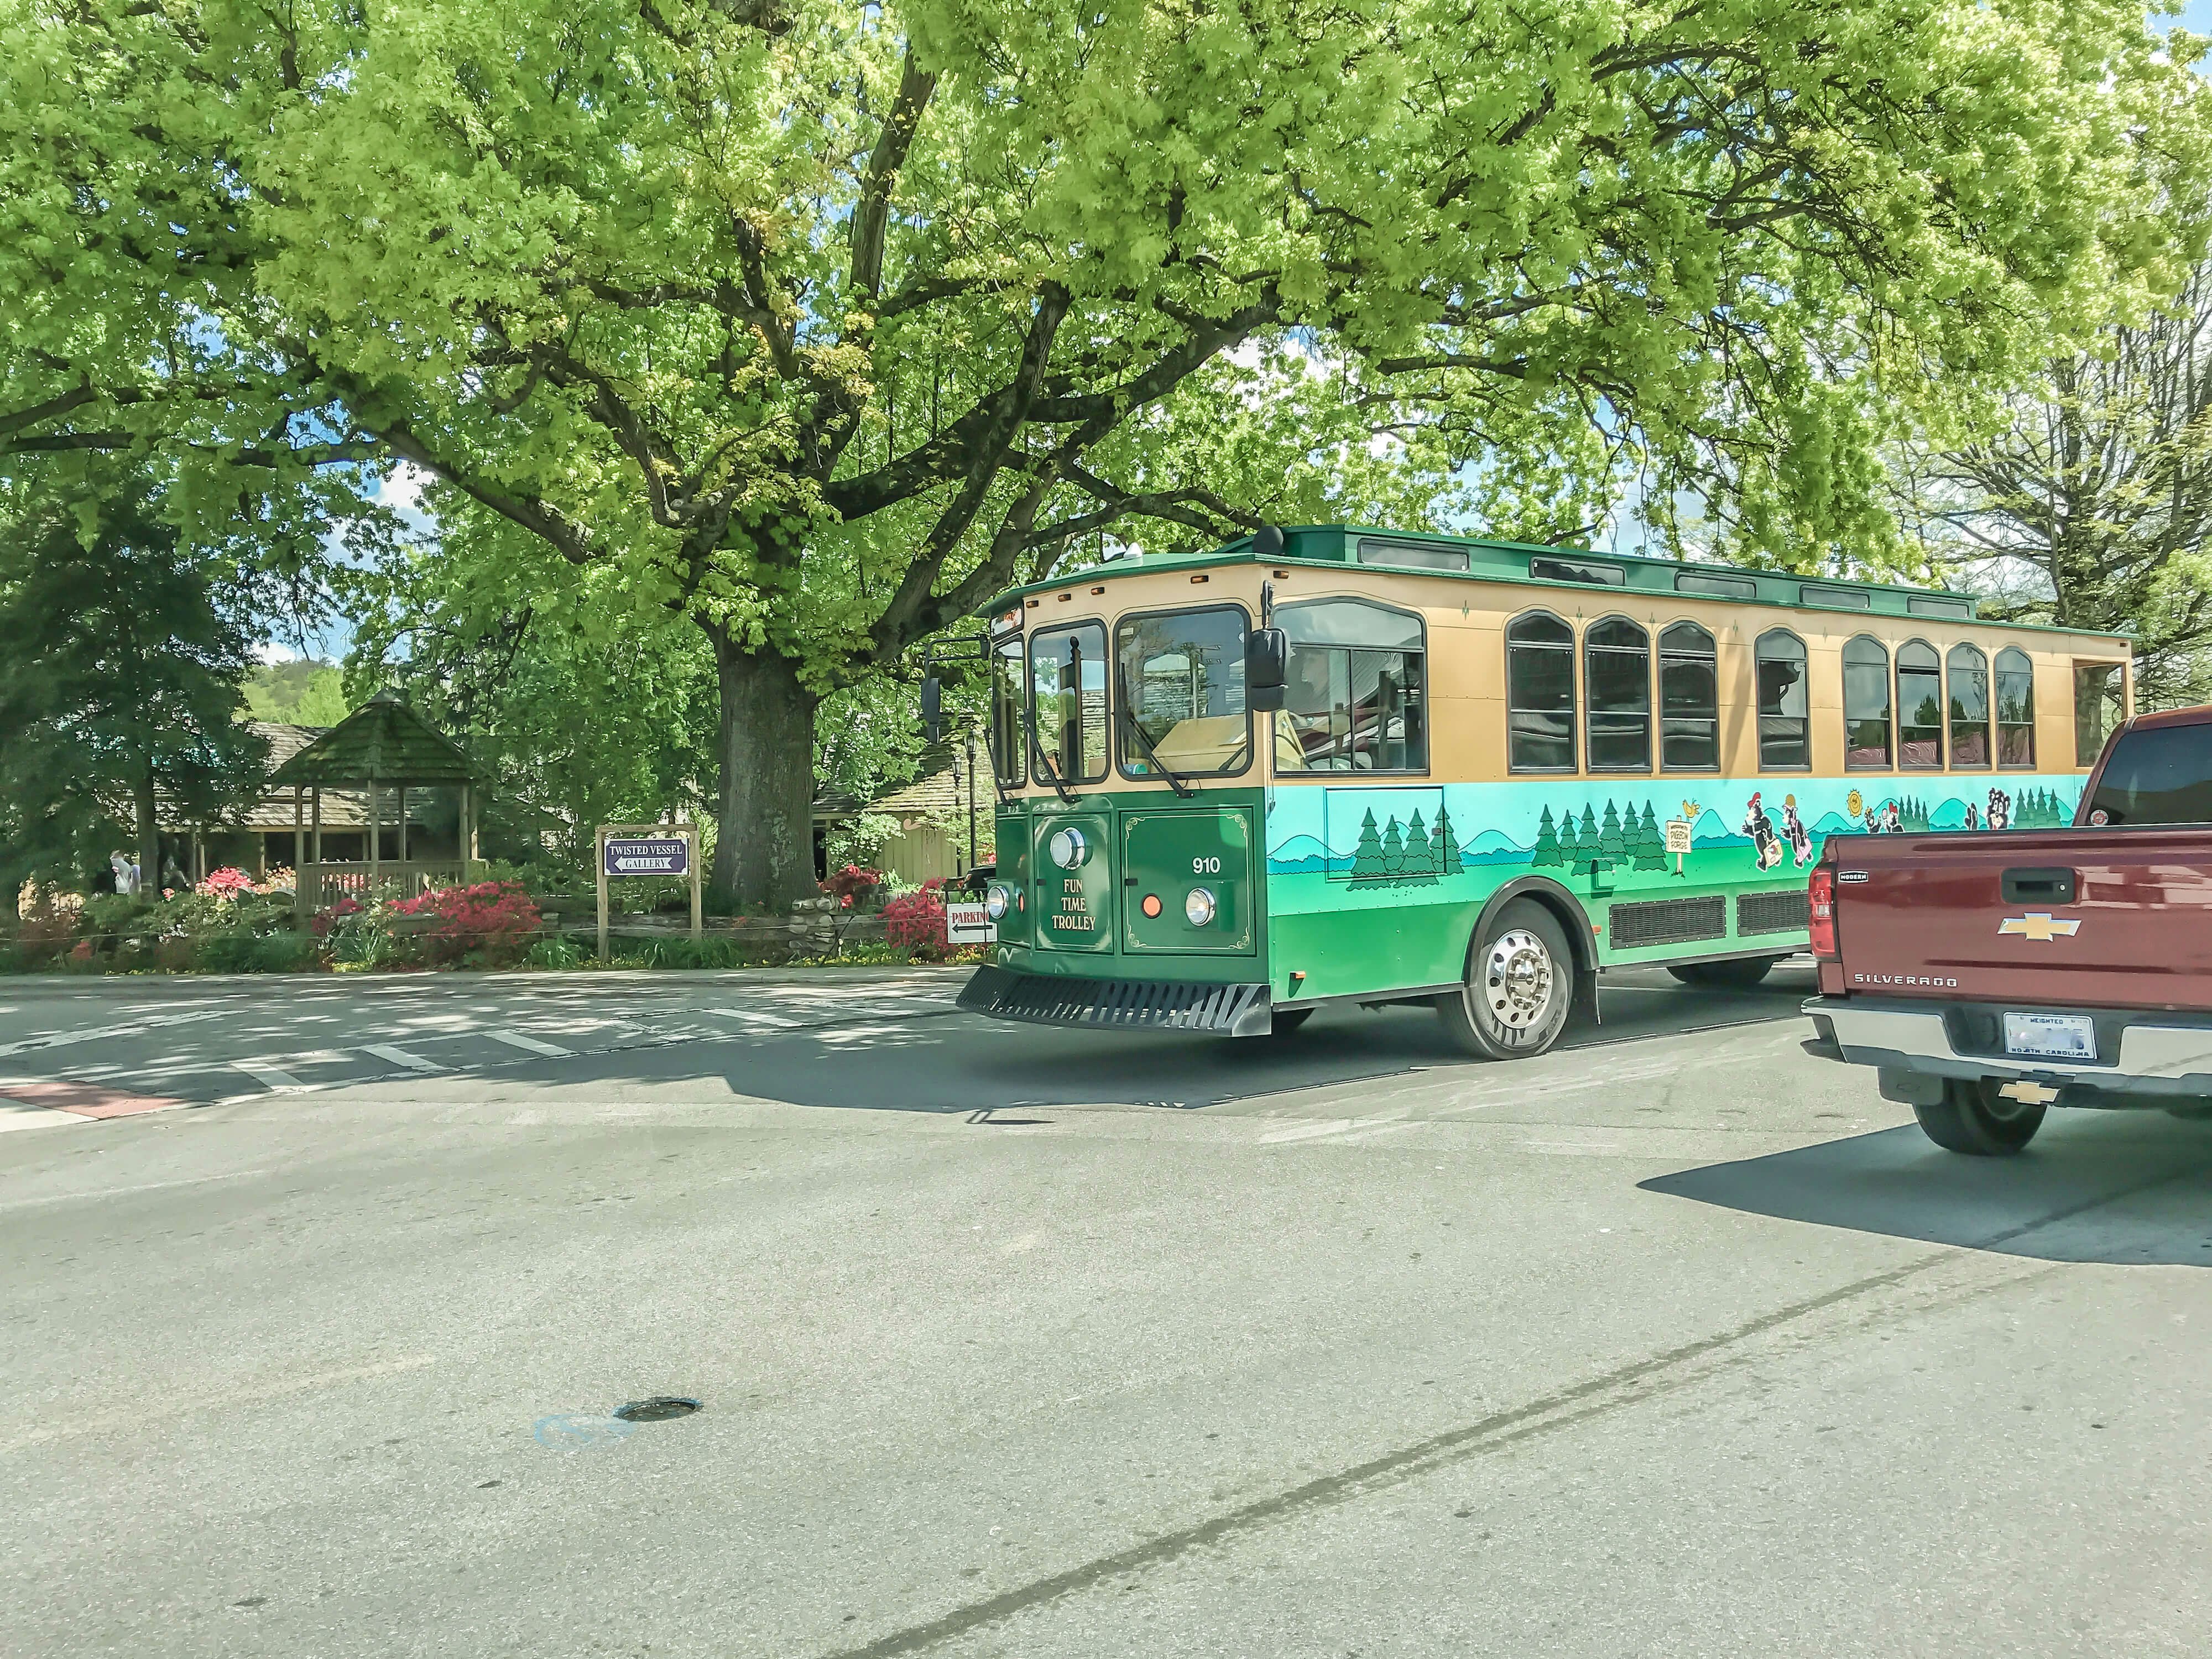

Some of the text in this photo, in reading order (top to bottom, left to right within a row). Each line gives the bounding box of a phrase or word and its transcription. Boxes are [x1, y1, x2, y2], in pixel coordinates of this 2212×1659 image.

[609, 844, 682, 855] TWISTED VESSEL
[625, 859, 666, 868] GALLERY
[1192, 857, 1221, 874] 910
[1063, 879, 1083, 894] FUN
[1061, 897, 1087, 912] TIME
[1051, 915, 1096, 931] TROLLEY
[1854, 973, 1958, 988] SILVERADO
